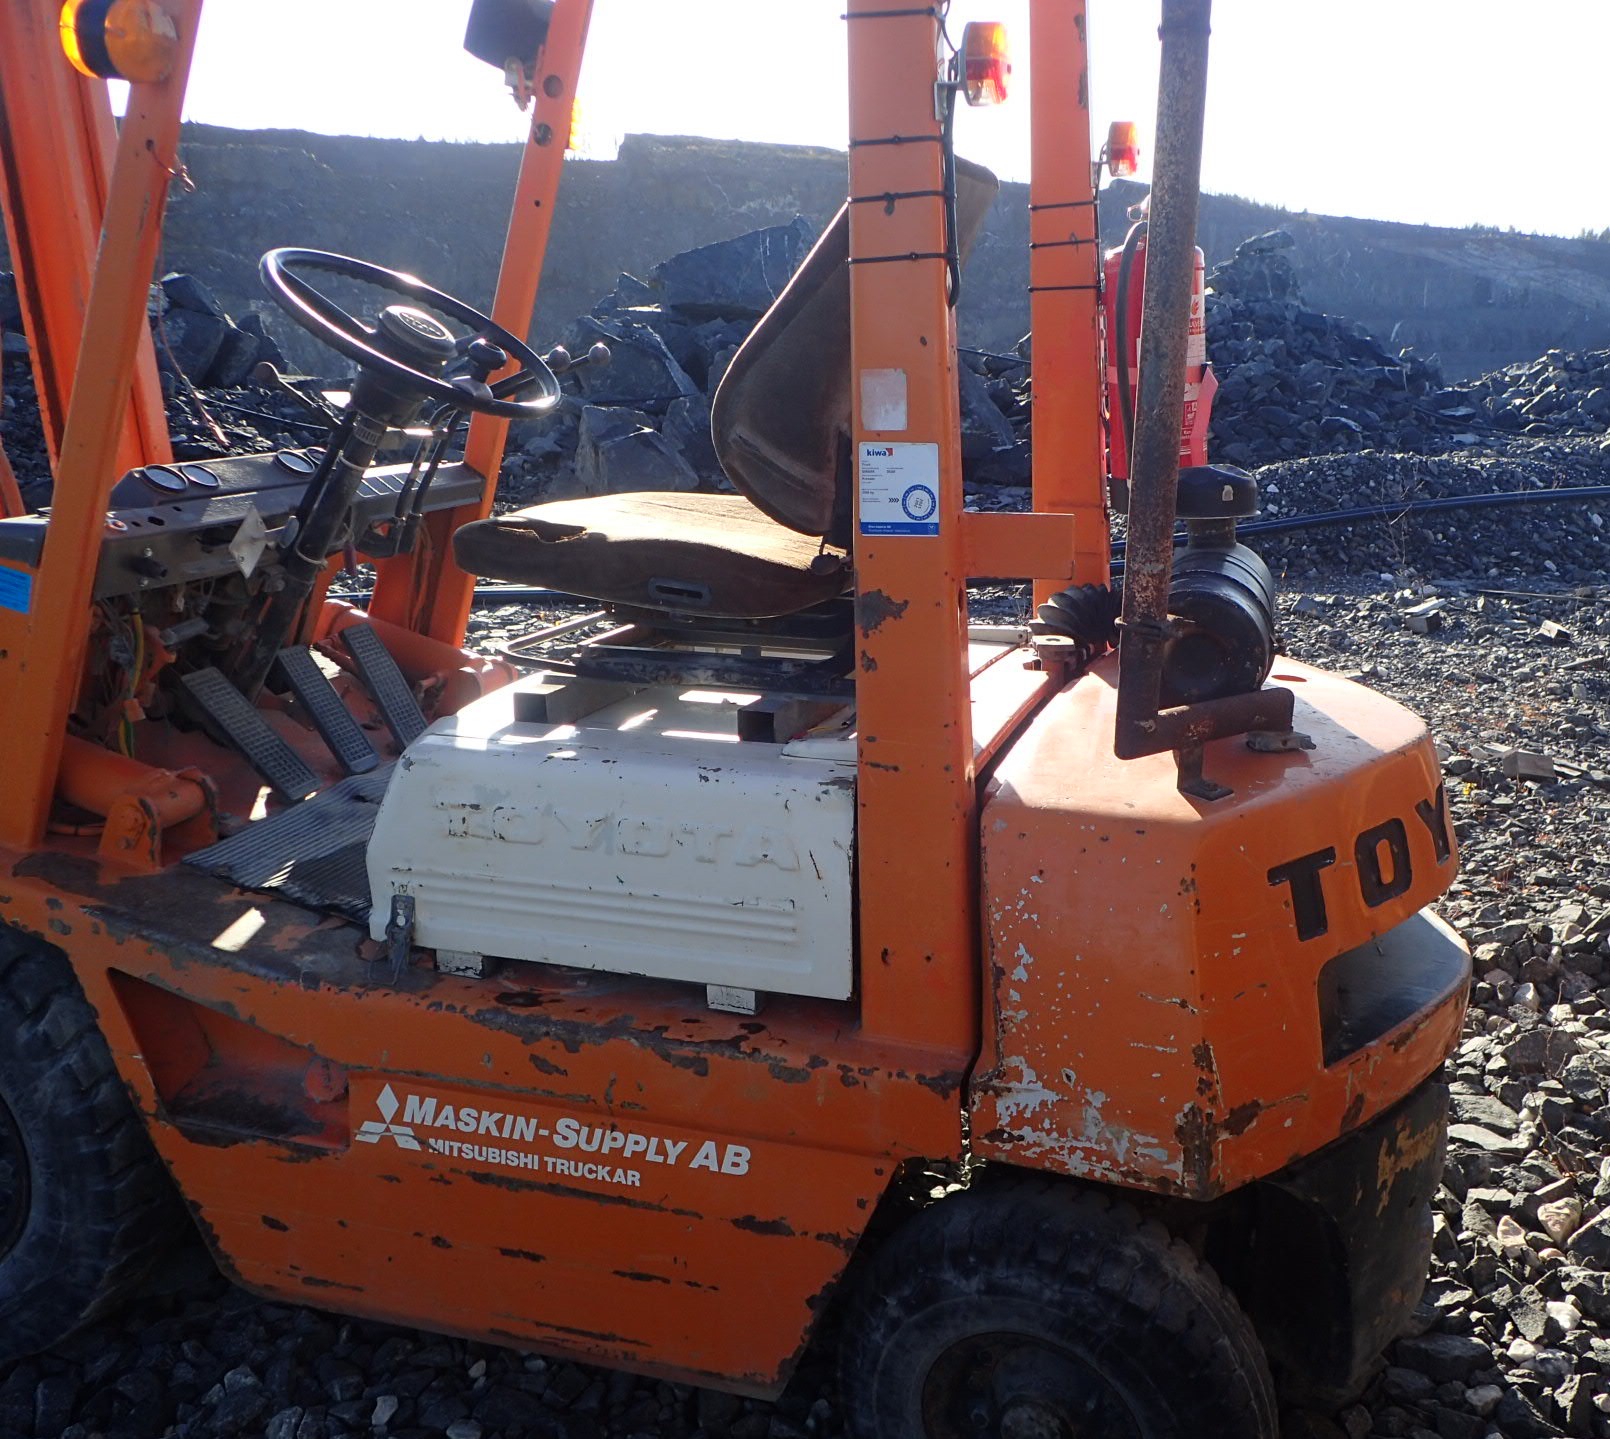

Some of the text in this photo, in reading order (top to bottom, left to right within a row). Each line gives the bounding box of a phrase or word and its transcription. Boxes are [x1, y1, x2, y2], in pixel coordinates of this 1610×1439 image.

[866, 448, 887, 457] kiwa
[1267, 781, 1450, 942] TOY
[428, 1138, 641, 1187] MITSUBISHI TRUCKAR
[689, 1141, 751, 1176] AB
